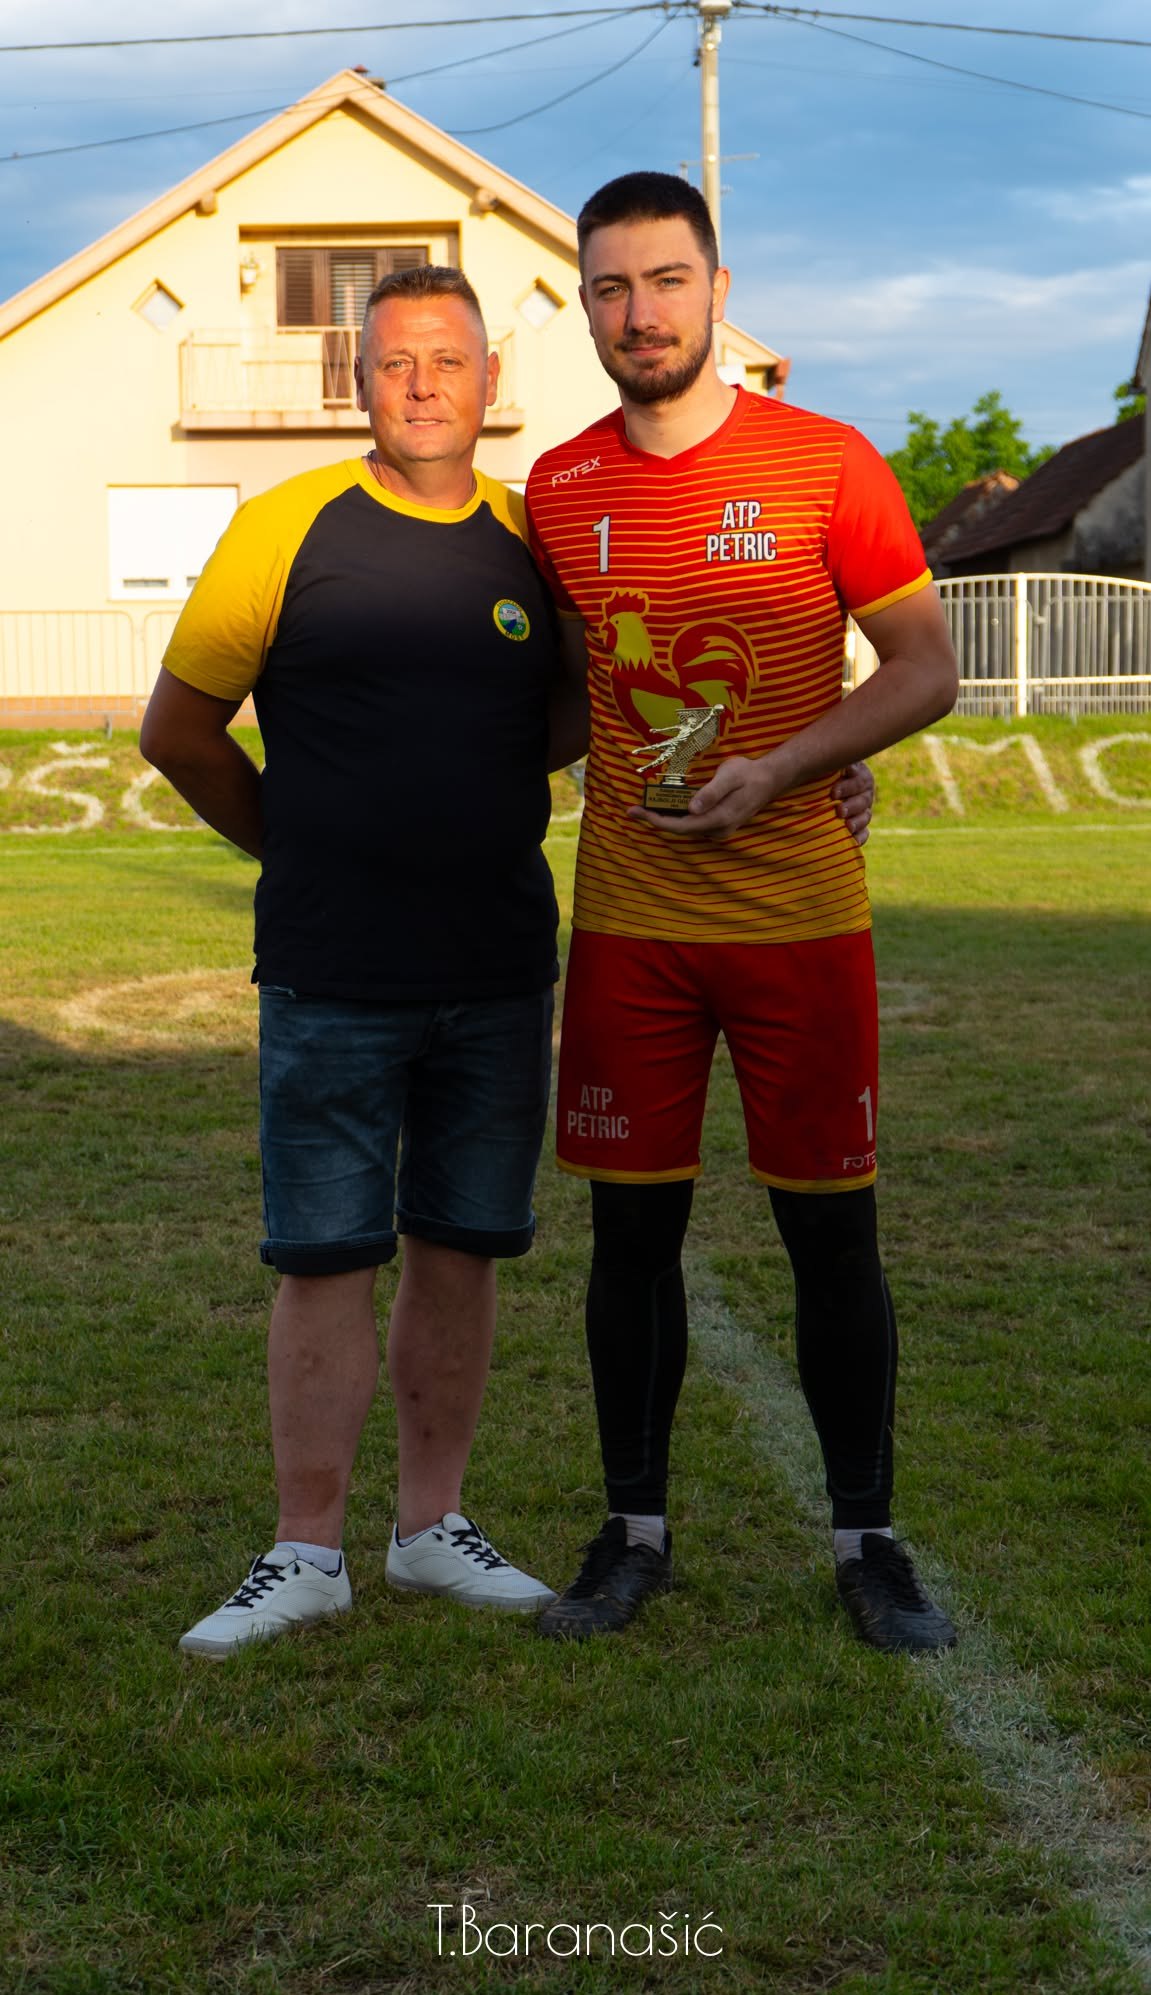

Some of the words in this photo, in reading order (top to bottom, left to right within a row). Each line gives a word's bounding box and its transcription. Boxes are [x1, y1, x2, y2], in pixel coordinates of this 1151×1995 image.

[551, 456, 600, 487] FOTEX
[722, 500, 761, 529] ATP
[592, 513, 611, 574] 1
[706, 531, 777, 562] PETRIC
[580, 1084, 613, 1111] ATP
[567, 1110, 629, 1139] PETRIC
[858, 1085, 873, 1142] 1
